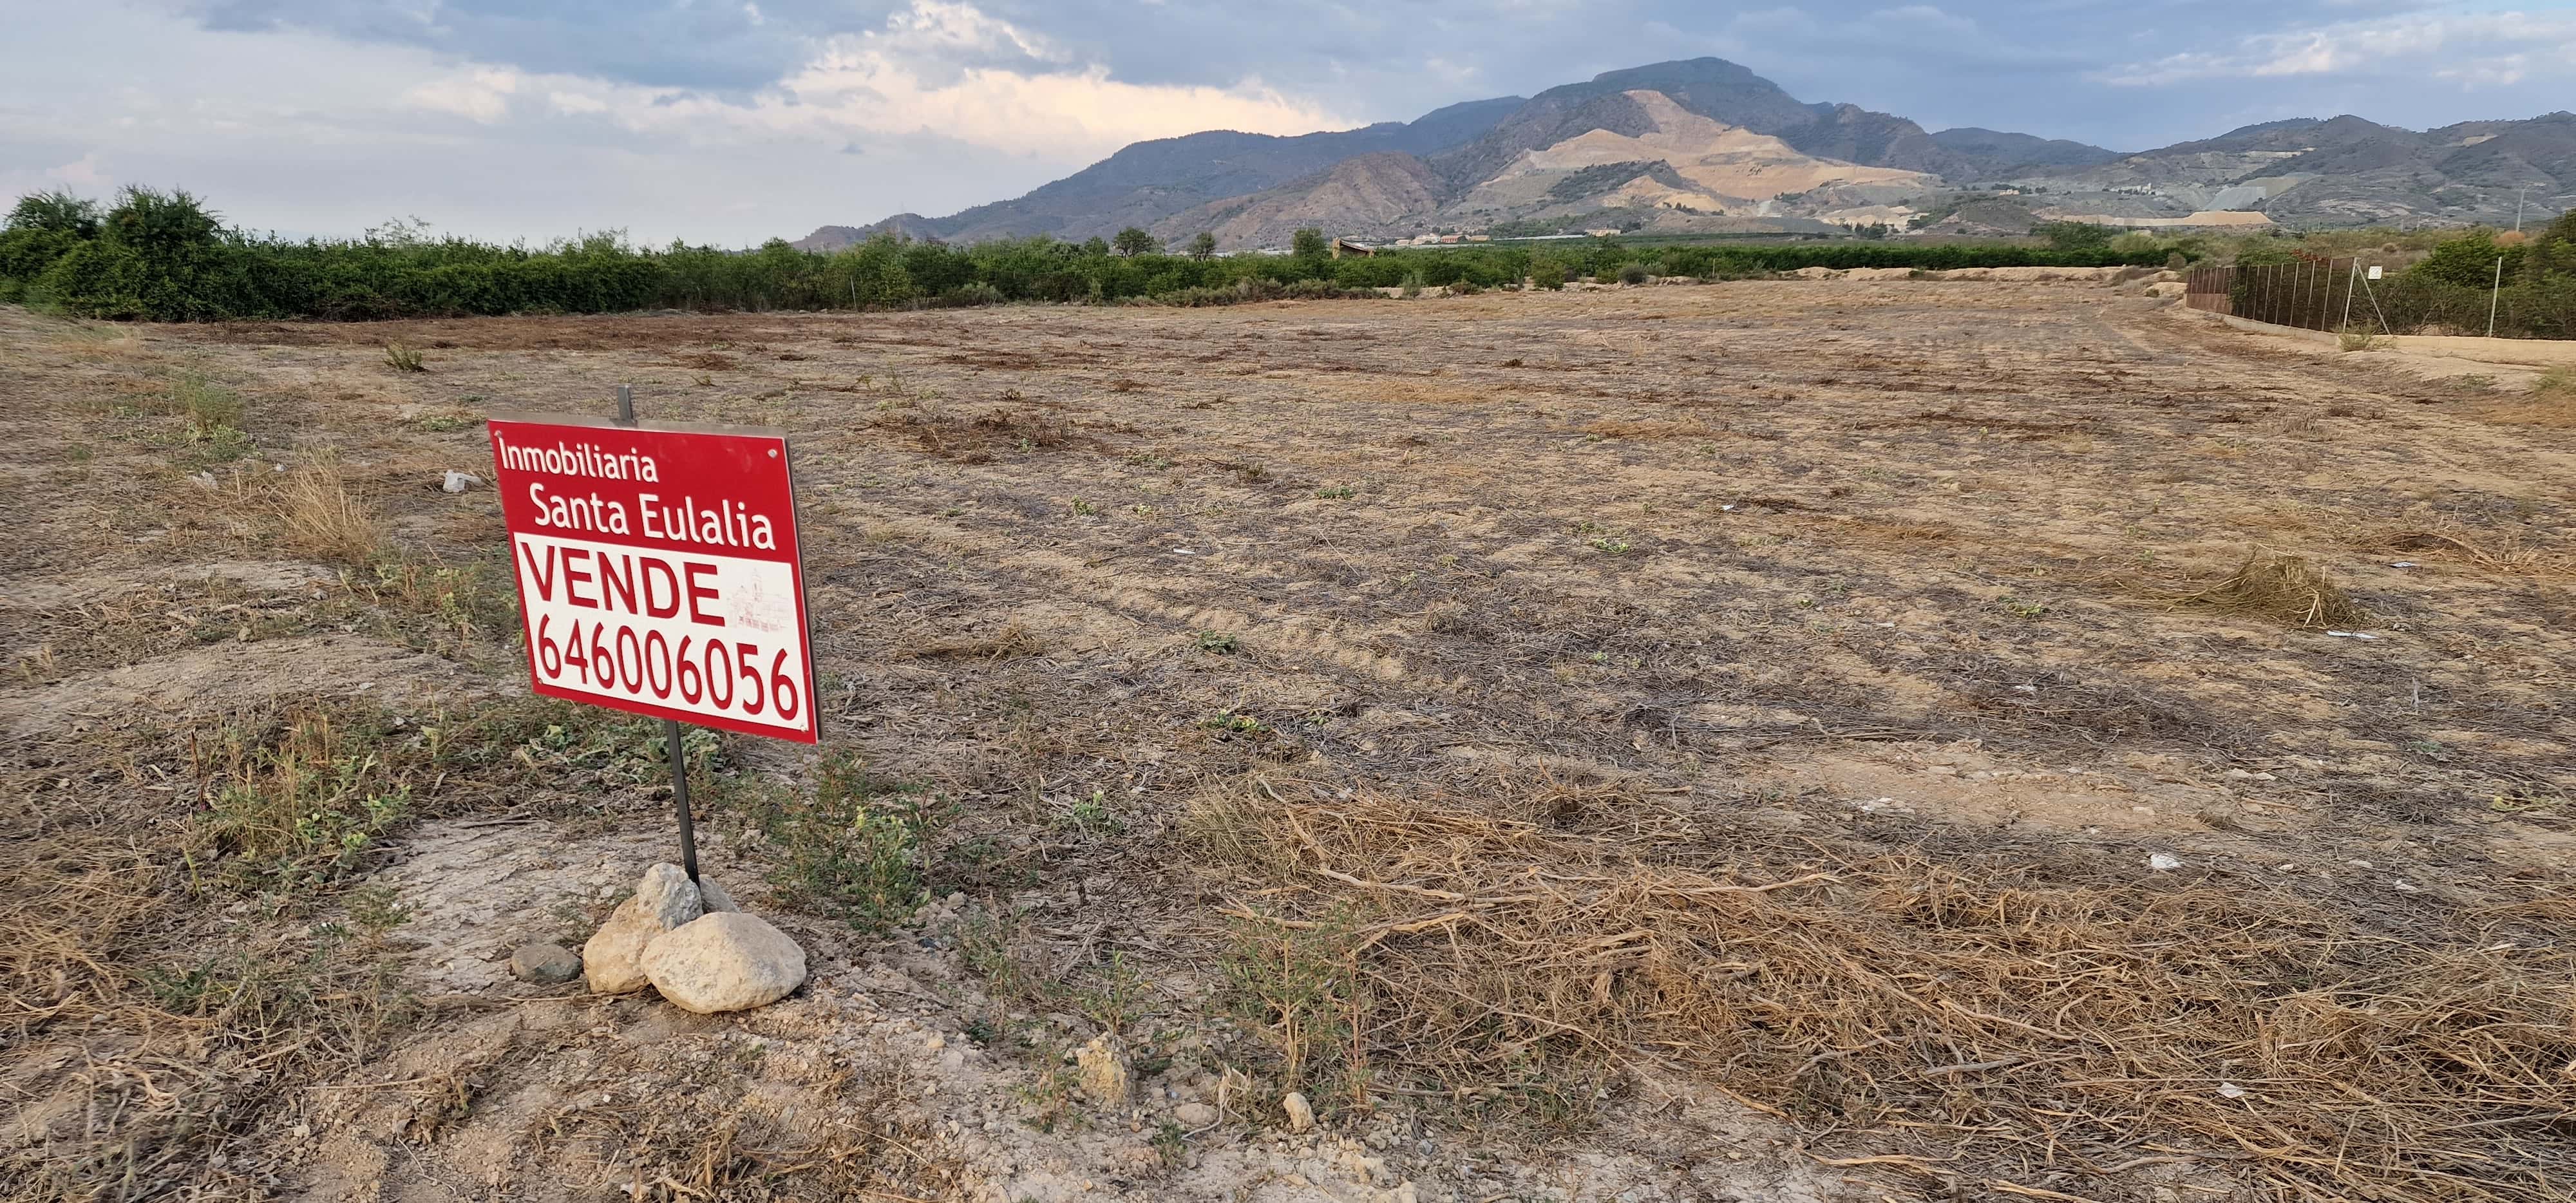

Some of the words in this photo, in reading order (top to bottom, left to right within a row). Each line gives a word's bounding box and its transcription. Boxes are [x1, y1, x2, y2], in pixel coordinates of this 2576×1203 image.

[498, 437, 658, 482] Inmobiliaria
[529, 482, 629, 535] Santa
[638, 493, 775, 551] Eulalia
[520, 542, 725, 627] VENDE
[538, 613, 799, 721] 646006056
